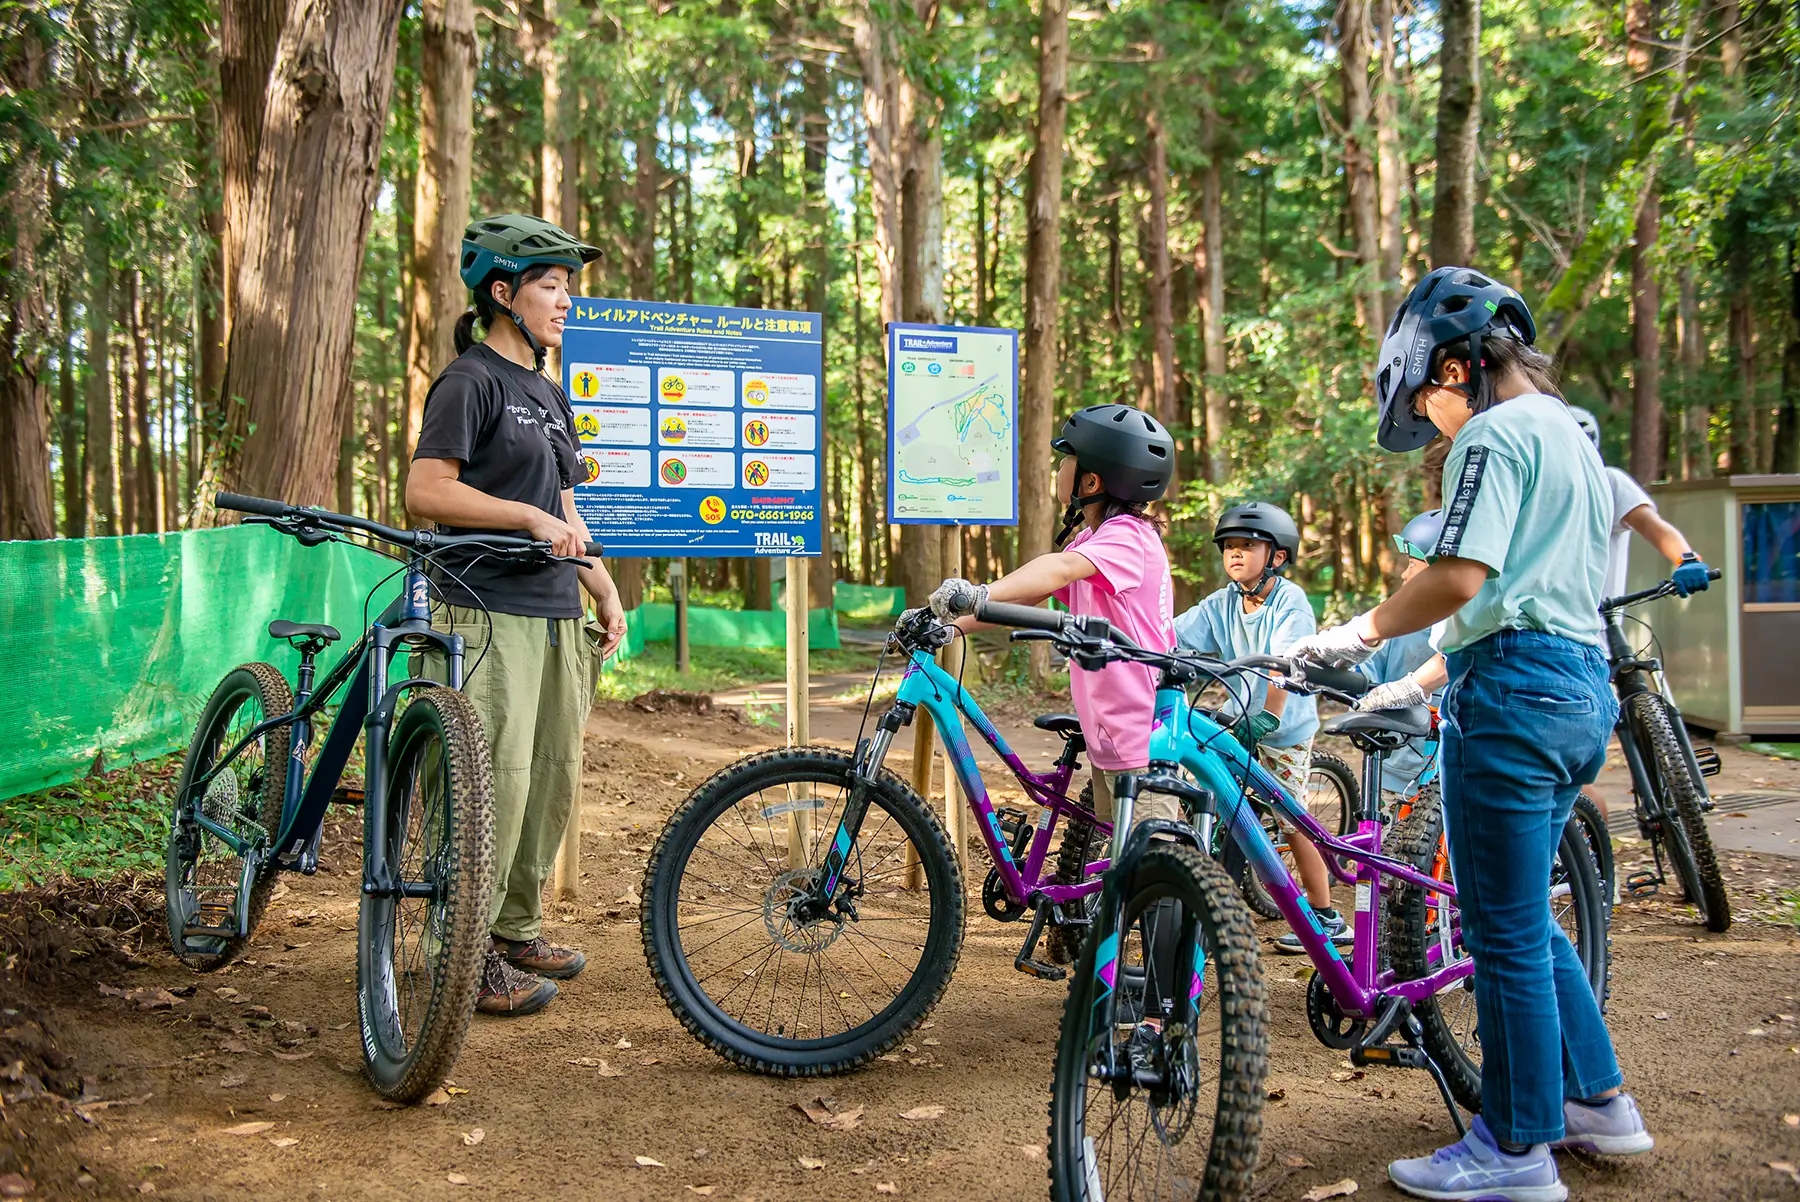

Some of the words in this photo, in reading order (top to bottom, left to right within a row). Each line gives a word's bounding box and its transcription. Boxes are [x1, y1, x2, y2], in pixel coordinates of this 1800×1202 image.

[493, 255, 518, 269] SMITH
[576, 305, 713, 327] トレイルアドベンチャー
[717, 315, 812, 334] ルールと注意事項
[1412, 338, 1428, 376] SMITH
[1463, 464, 1479, 488] SMILE
[1453, 496, 1469, 514] LOVE
[730, 510, 815, 521] 070-6661-1966
[755, 532, 790, 546] TRAIL
[1441, 526, 1459, 549] SMILE
